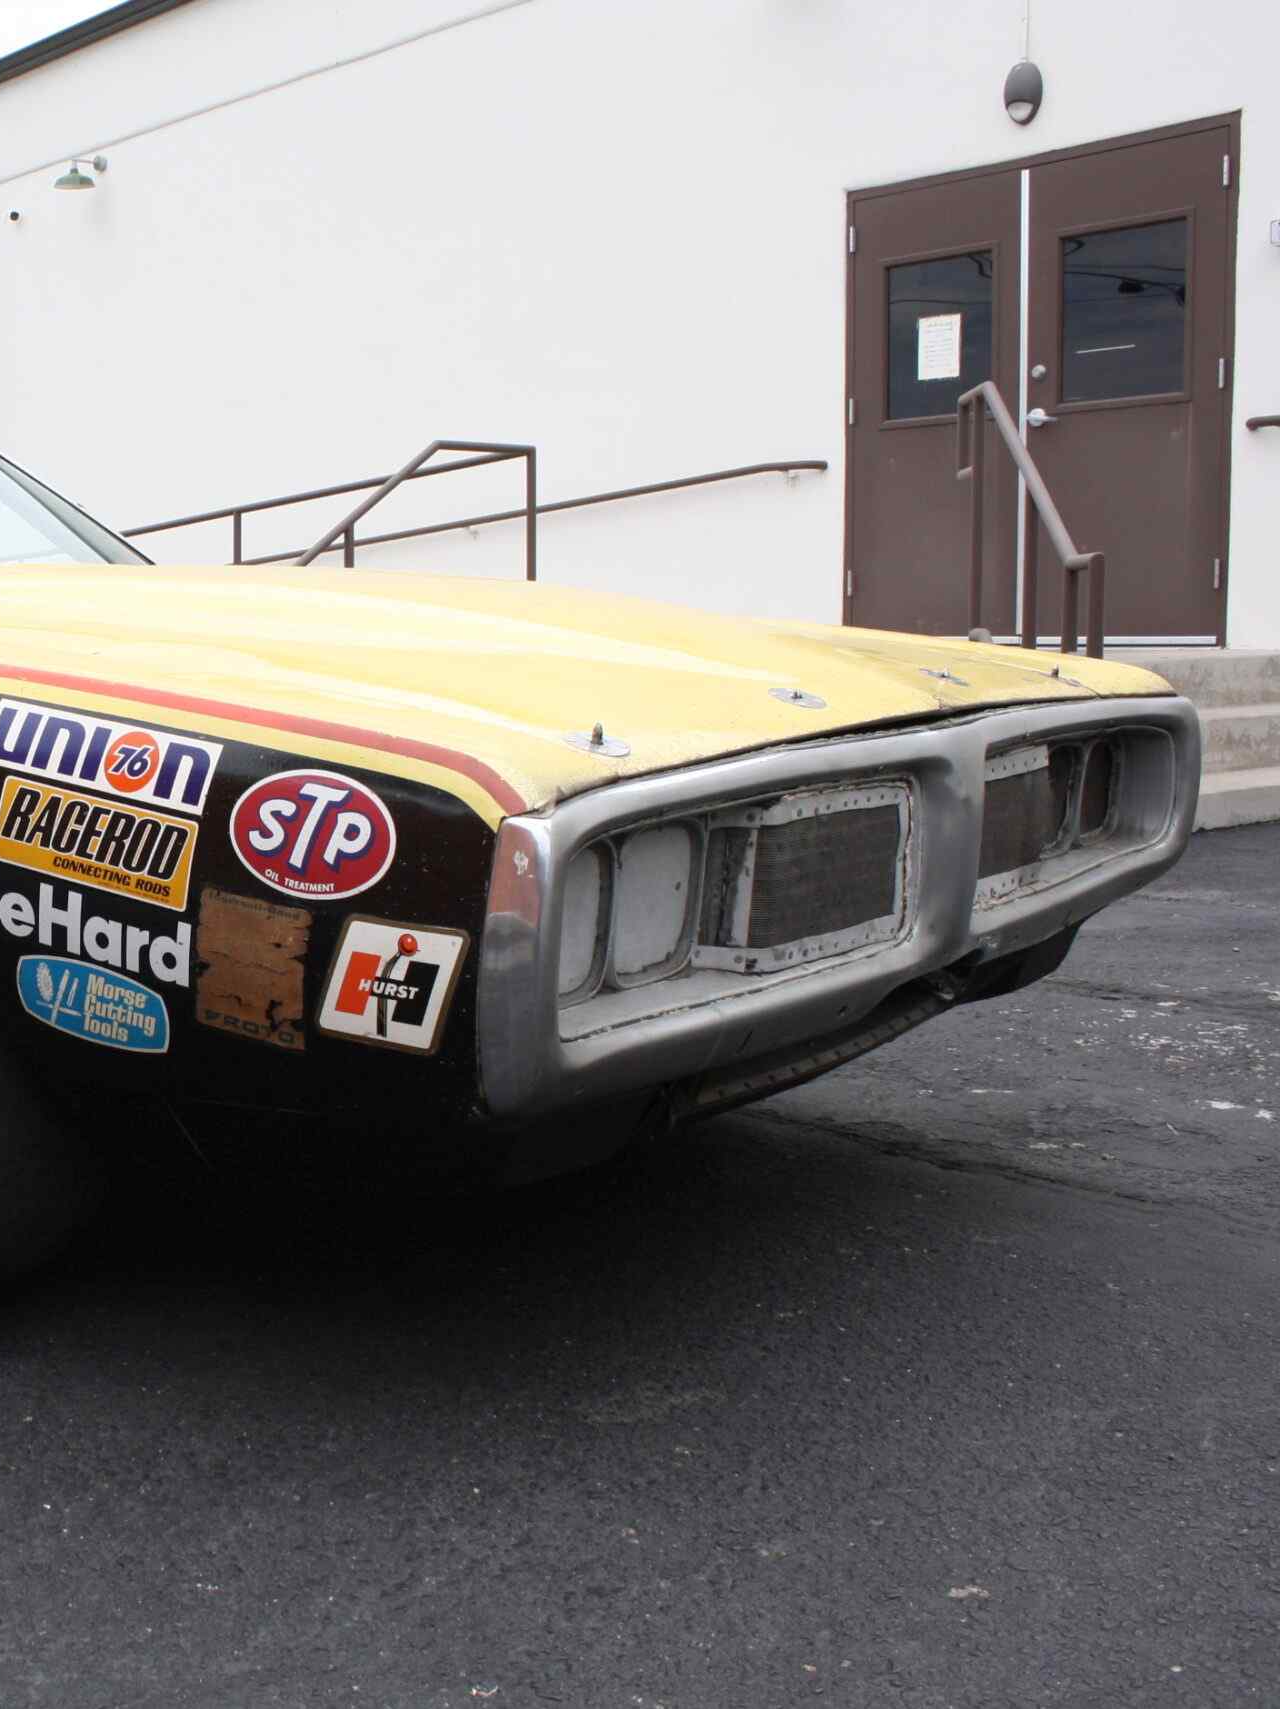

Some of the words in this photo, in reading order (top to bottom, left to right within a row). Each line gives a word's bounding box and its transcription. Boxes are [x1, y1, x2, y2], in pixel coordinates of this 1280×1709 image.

[108, 747, 151, 778] 76
[1, 787, 188, 880] RACEROD
[249, 783, 372, 868] STP
[52, 855, 130, 886] CONNECTING
[135, 878, 170, 897] RODS
[264, 868, 280, 882] OIL
[284, 877, 336, 892] TREATMENT
[86, 974, 147, 1009] Morse
[357, 978, 420, 1000] HURST
[83, 1013, 129, 1042] Tools
[84, 994, 157, 1037] Cutting
